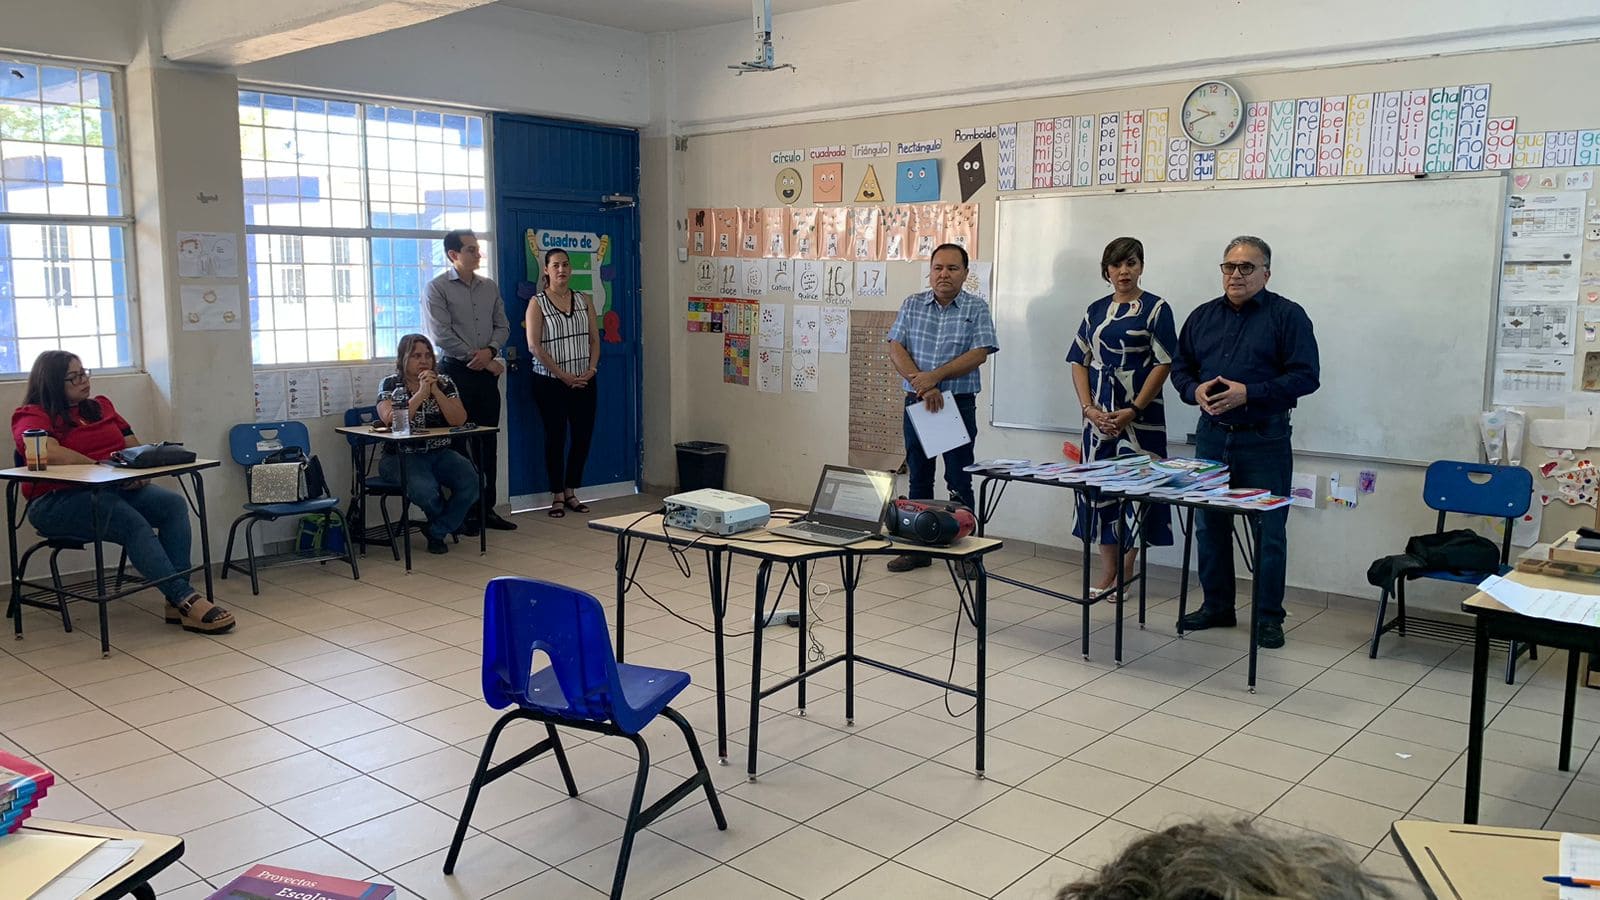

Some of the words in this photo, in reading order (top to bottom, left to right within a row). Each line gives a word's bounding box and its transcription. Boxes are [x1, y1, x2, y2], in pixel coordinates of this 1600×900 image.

[1210, 85, 1218, 94] 12
[1432, 88, 1458, 104] cha
[1462, 85, 1488, 102] ña
[1323, 98, 1344, 112] ba
[1349, 96, 1369, 111] fa
[1377, 92, 1398, 108] lla
[1404, 91, 1426, 107] ja
[1233, 108, 1239, 117] 3
[1248, 103, 1267, 117] da
[1274, 102, 1293, 116] va
[1298, 100, 1318, 114] ra
[1431, 105, 1456, 121] che
[1460, 103, 1486, 120] ñe
[1056, 118, 1071, 128] sa
[1079, 117, 1090, 128] la
[1101, 115, 1118, 128] pa
[1124, 111, 1143, 124] ta
[1298, 115, 1318, 130] re
[1322, 114, 1343, 128] be
[1348, 112, 1365, 127] fe
[1374, 110, 1396, 124] lle
[1402, 108, 1424, 124] je
[1036, 122, 1053, 132] ma
[1247, 119, 1265, 133] de
[1272, 116, 1292, 131] ve
[1429, 122, 1454, 138] chi
[1488, 119, 1514, 136] ga
[954, 126, 996, 140] Romboide
[1000, 127, 1016, 136] wa
[1055, 133, 1070, 144] se
[1079, 131, 1088, 144] le
[1100, 128, 1116, 141] pe
[1122, 126, 1140, 139] te
[1220, 130, 1226, 138] 5
[1296, 130, 1312, 146] ri
[1320, 129, 1340, 145] bi
[1347, 128, 1360, 142] fi
[1400, 124, 1417, 140] ji
[999, 140, 1015, 149] we
[1036, 135, 1052, 146] me
[1170, 139, 1188, 151] ca
[1246, 134, 1264, 148] di
[1271, 132, 1288, 146] vi
[1458, 137, 1482, 154] ño
[1488, 135, 1514, 152] go
[1516, 134, 1544, 150] gue
[1547, 132, 1576, 149] güe
[810, 146, 846, 158] cuadrado
[853, 144, 889, 158] Triángulo
[898, 139, 942, 154] Rectángulo
[1035, 147, 1050, 160] mi
[1055, 146, 1068, 159] si
[1078, 144, 1086, 157] li
[1100, 141, 1112, 156] pi
[1122, 140, 1138, 154] ti
[1296, 147, 1315, 160] ro
[1320, 146, 1342, 160] bo
[1346, 144, 1362, 159] fo
[1372, 142, 1394, 157] llo
[1398, 141, 1420, 157] jo
[1428, 139, 1454, 155] cho
[773, 150, 800, 164] círculo
[998, 150, 1014, 162] wi
[1121, 156, 1140, 168] to
[1169, 154, 1188, 166] co
[1194, 152, 1214, 166] que
[1218, 152, 1237, 164] ce
[1245, 149, 1265, 164] do
[1270, 148, 1292, 162] vo
[1580, 148, 1599, 165] gi
[1035, 162, 1052, 173] mo
[1054, 160, 1070, 172] so
[1077, 159, 1089, 172] lo
[1099, 158, 1115, 170] po
[1269, 162, 1290, 178] vu
[1295, 163, 1314, 176] ru
[1318, 160, 1338, 176] bu
[1346, 160, 1363, 175] fu
[1398, 158, 1418, 174] ju
[1426, 156, 1452, 172] chu
[1121, 169, 1142, 182] tu
[1168, 168, 1188, 181] cu
[1244, 165, 1264, 179] du
[998, 179, 1015, 189] wu
[1034, 176, 1053, 188] mu
[1054, 174, 1071, 186] su
[1076, 174, 1088, 186] lu
[543, 233, 578, 248] Cuadro
[580, 236, 592, 248] de
[723, 265, 736, 284] 12
[825, 266, 846, 296] 16
[862, 270, 880, 288] 17
[720, 286, 736, 296] doce
[798, 292, 818, 301] quince
[256, 870, 318, 888] Proyectos
[275, 888, 336, 900] Escola
